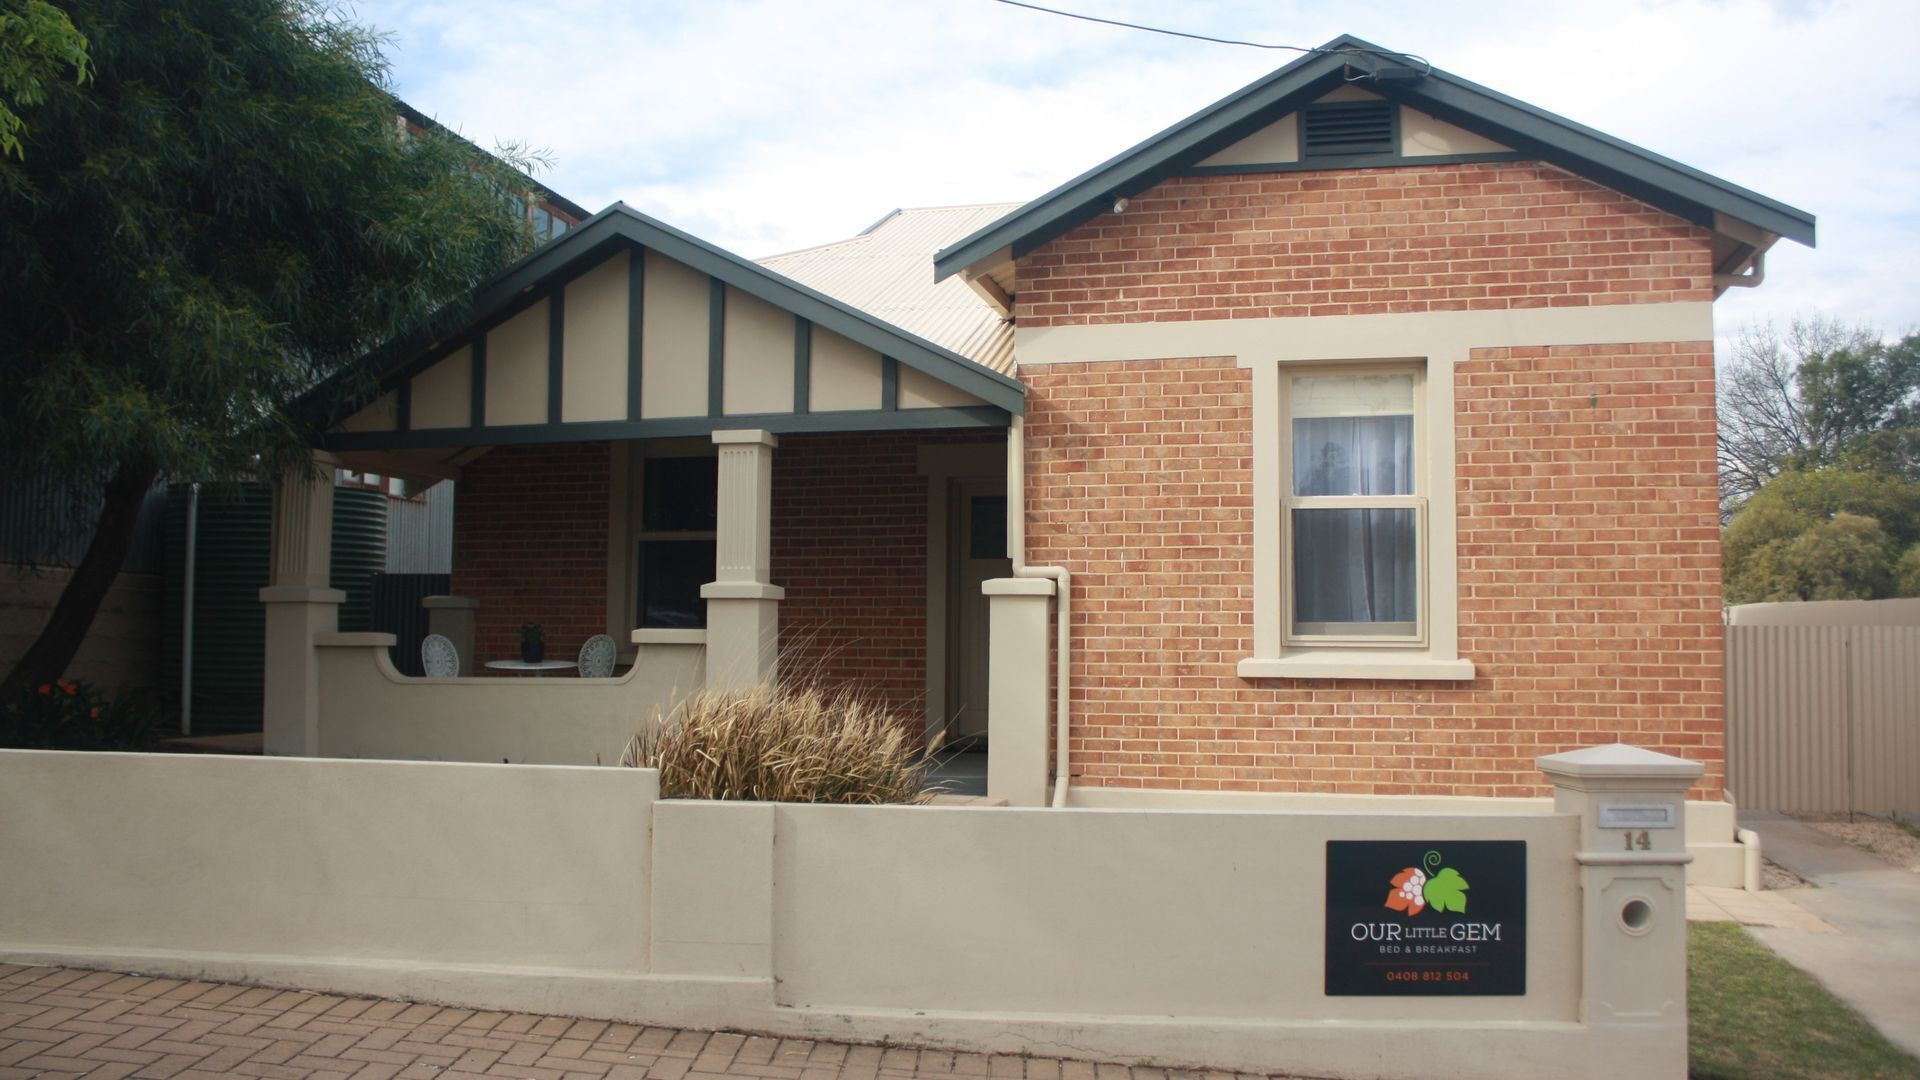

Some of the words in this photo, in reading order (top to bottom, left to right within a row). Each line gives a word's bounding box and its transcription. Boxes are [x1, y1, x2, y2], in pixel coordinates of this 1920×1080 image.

[1623, 831, 1651, 850] 14
[1351, 923, 1402, 941] OUR
[1404, 927, 1447, 938] LITTLE
[1450, 923, 1501, 941] GEM
[1379, 945, 1400, 954] BED
[1404, 945, 1411, 954] &
[1415, 945, 1477, 954] BREAKFAST
[1386, 971, 1418, 981] 0408
[1422, 971, 1441, 981] 812
[1446, 971, 1470, 981] 504
